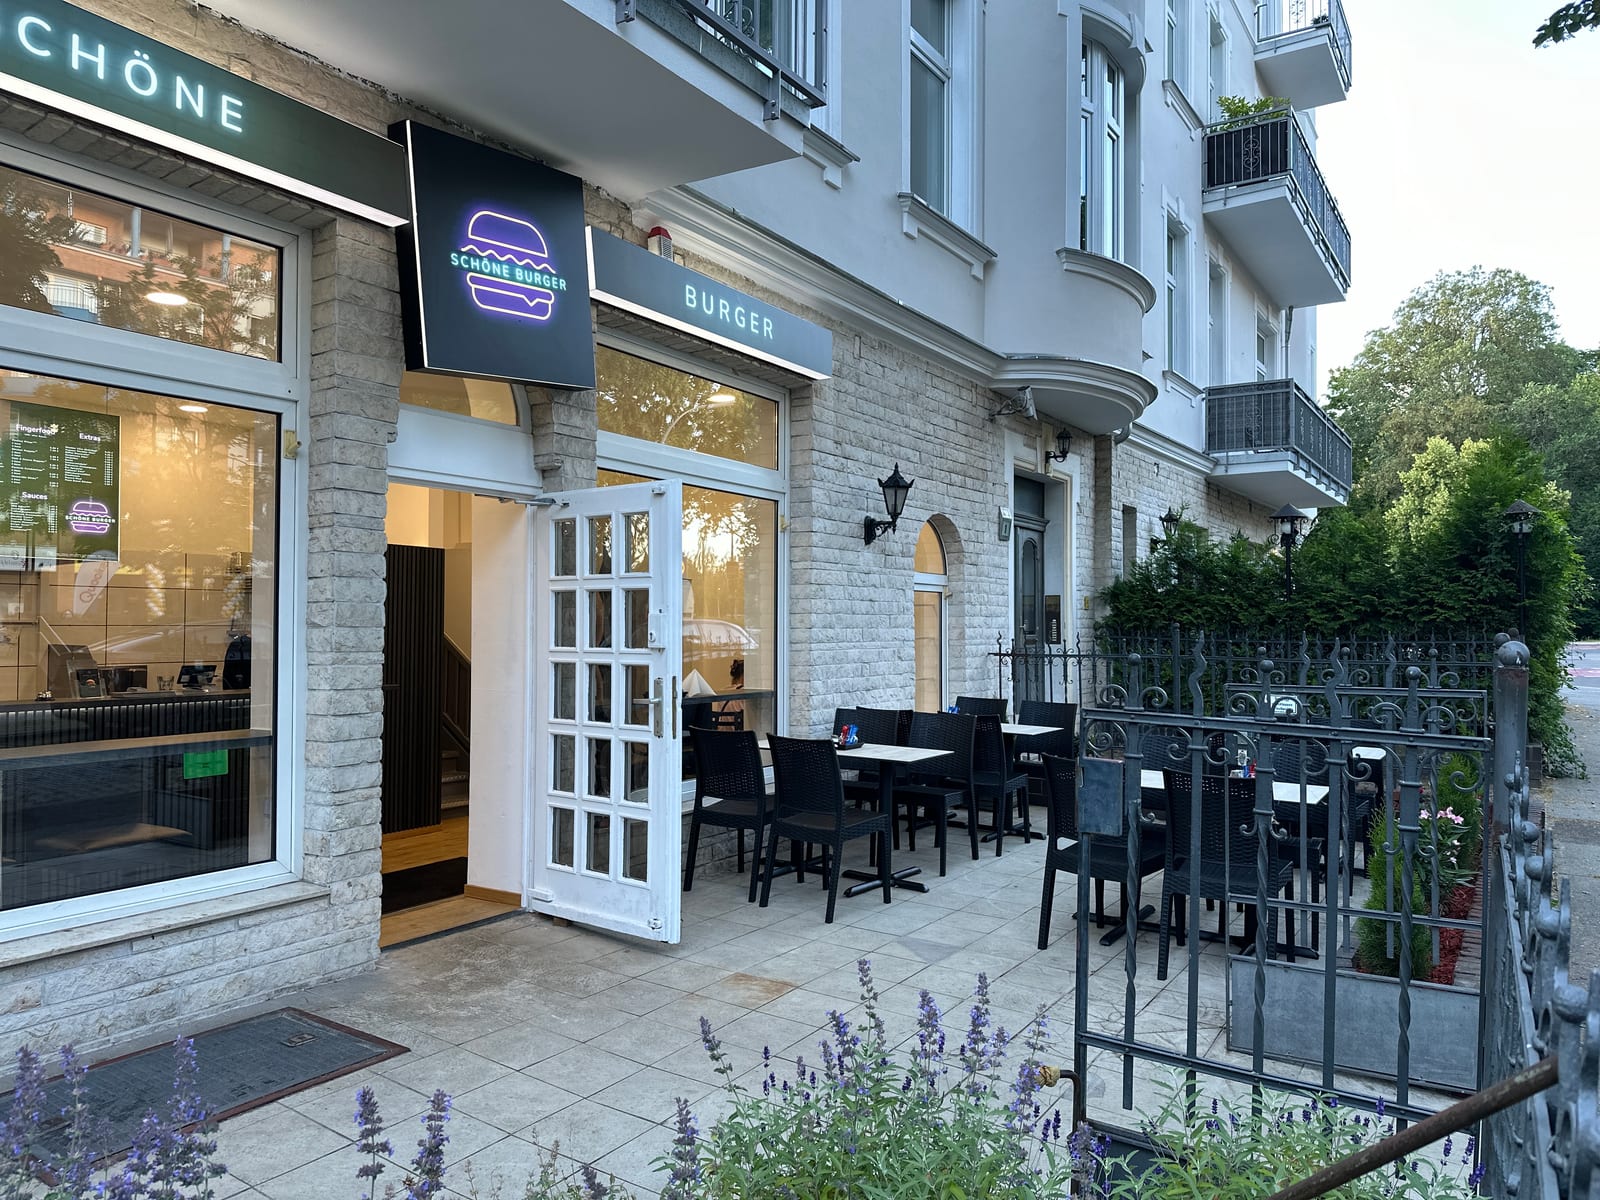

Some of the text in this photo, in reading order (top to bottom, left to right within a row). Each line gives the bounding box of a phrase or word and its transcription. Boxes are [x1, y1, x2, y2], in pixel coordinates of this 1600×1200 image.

[16, 15, 243, 132] CHÖNE
[450, 253, 567, 291] SCHÖNE BURGER
[685, 284, 773, 340] BURGER
[15, 423, 56, 435] Fingerfood
[79, 432, 101, 442] Extras
[22, 491, 48, 500] Sauces
